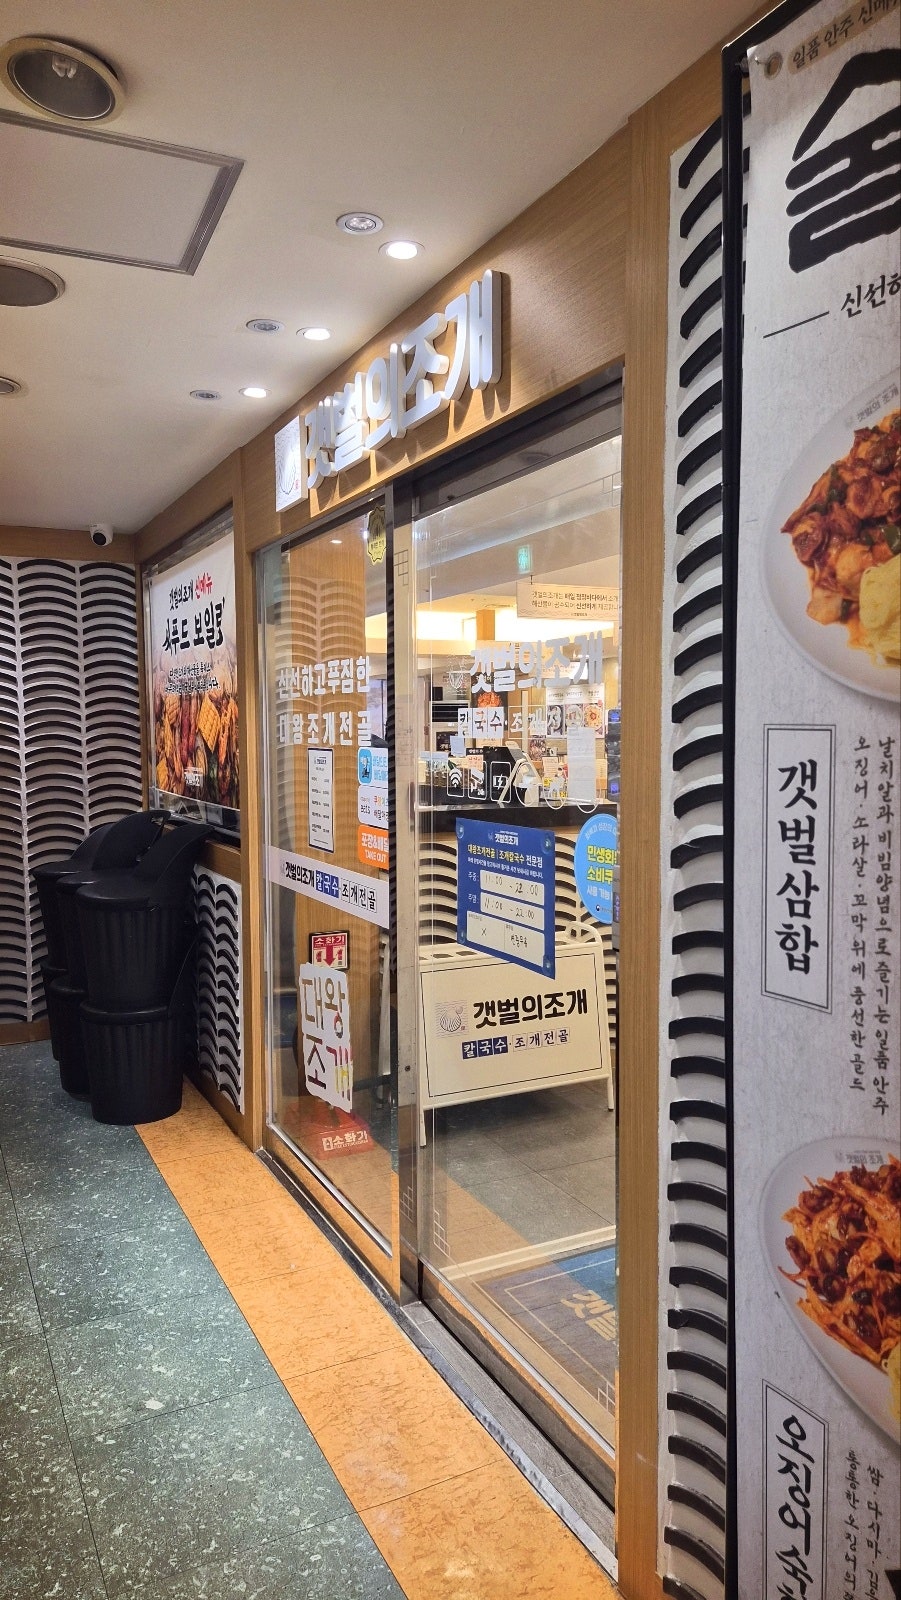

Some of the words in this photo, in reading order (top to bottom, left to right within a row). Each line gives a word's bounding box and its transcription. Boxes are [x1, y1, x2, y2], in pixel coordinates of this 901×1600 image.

[793, 36, 820, 68] 일품
[824, 15, 854, 47] 안주
[304, 269, 500, 489] 갯벌의조개
[470, 630, 602, 694] 갯벌의조개
[877, 736, 895, 824] 날치알과
[365, 849, 376, 861] TAKE
[377, 852, 387, 864] OUT
[468, 844, 496, 859] 대왕조개전골
[499, 850, 525, 864] 조개칼국수
[526, 854, 543, 868] 전문점
[494, 833, 519, 846] 갯벌의조개
[587, 845, 617, 866] 민생회
[285, 862, 315, 887] 갯벌의조개
[775, 759, 819, 975] 갯벌삼합
[874, 829, 894, 957] 비빔양념으로
[314, 936, 345, 945] 소화기
[852, 940, 866, 981] 위에
[301, 976, 346, 1039] 대왕
[473, 989, 588, 1029] 갯벌의조개
[872, 961, 892, 1024] 즐기는
[873, 1029, 889, 1071] 일품
[873, 1075, 889, 1116] 안주
[332, 1131, 368, 1145] 소화기
